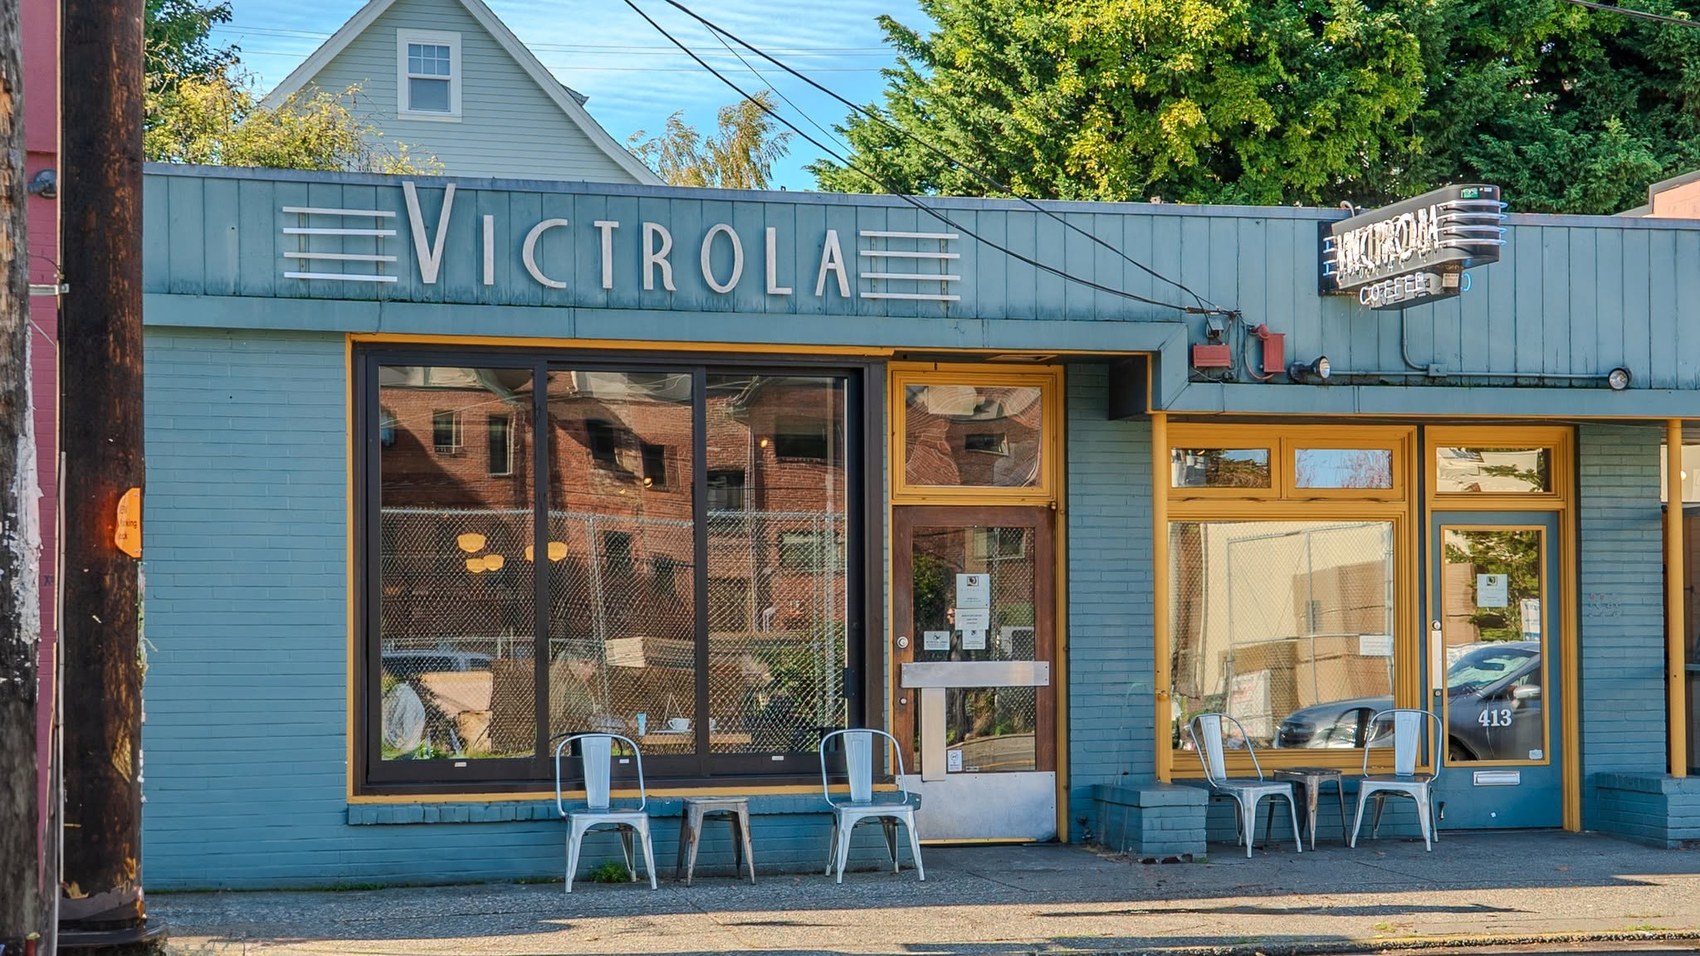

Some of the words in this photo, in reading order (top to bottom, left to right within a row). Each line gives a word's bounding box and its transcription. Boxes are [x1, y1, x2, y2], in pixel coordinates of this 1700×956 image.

[402, 182, 850, 298] VICTROLA
[1360, 272, 1425, 305] COFFEE
[1479, 709, 1512, 727] 413
